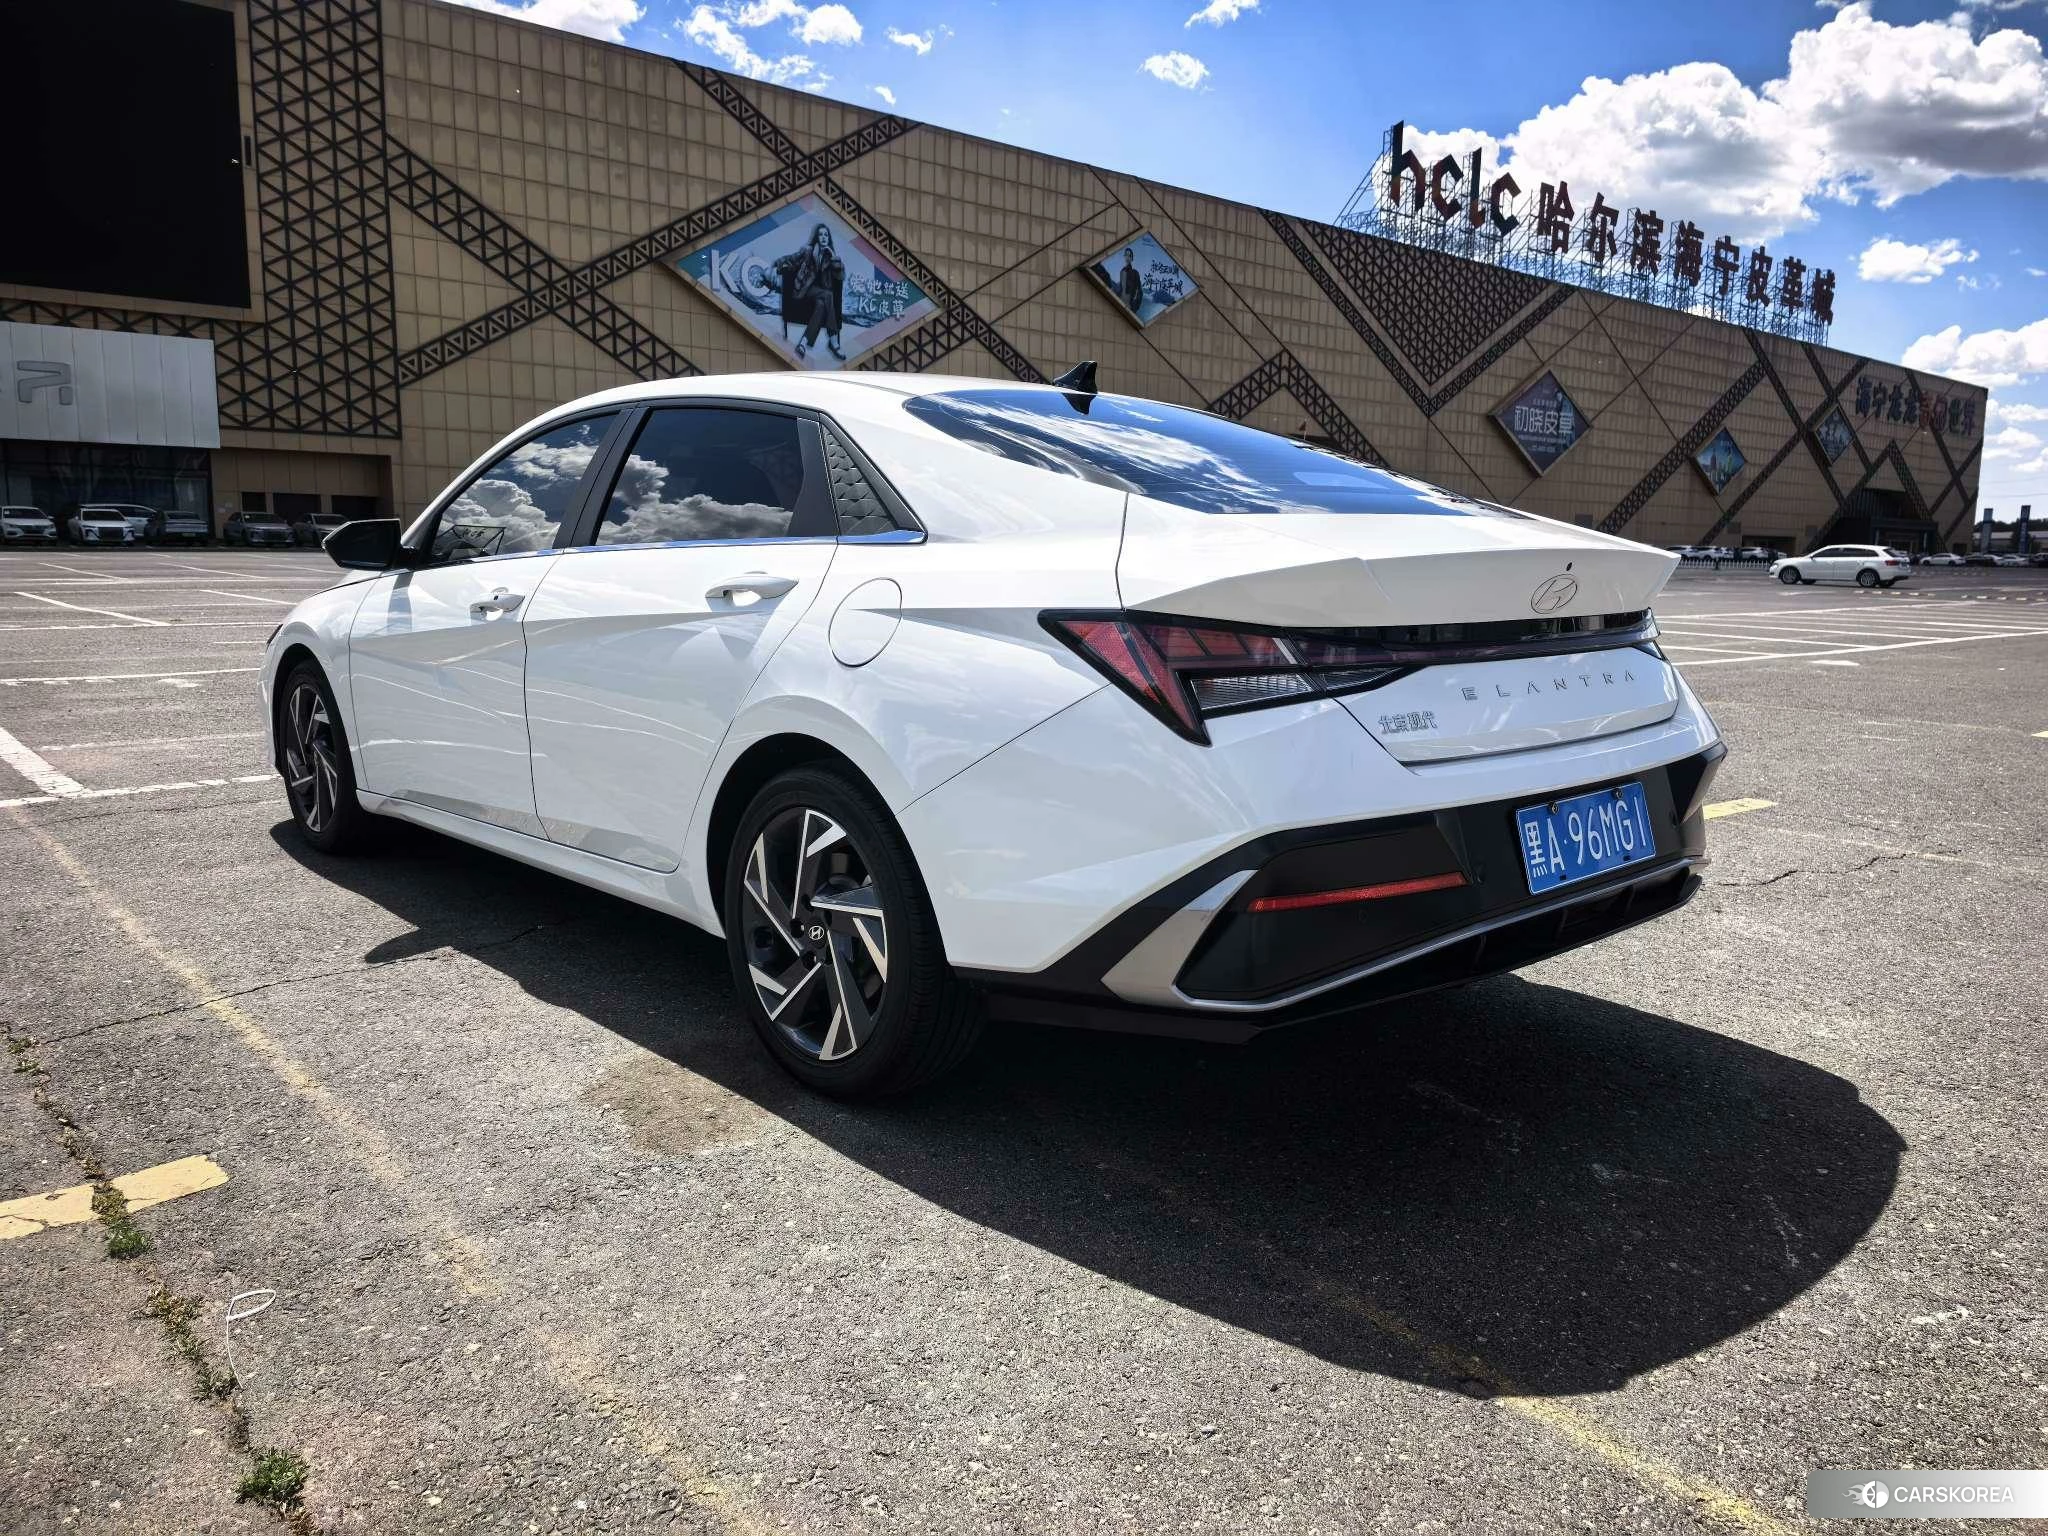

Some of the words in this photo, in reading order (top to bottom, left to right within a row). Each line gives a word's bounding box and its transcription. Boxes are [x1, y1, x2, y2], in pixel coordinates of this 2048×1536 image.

[1391, 120, 1522, 237] hclc
[1537, 180, 1836, 326] 哈尔滨海宁皮革城
[1461, 670, 1635, 700] ELANTRA
[1378, 711, 1438, 733] 北京现代
